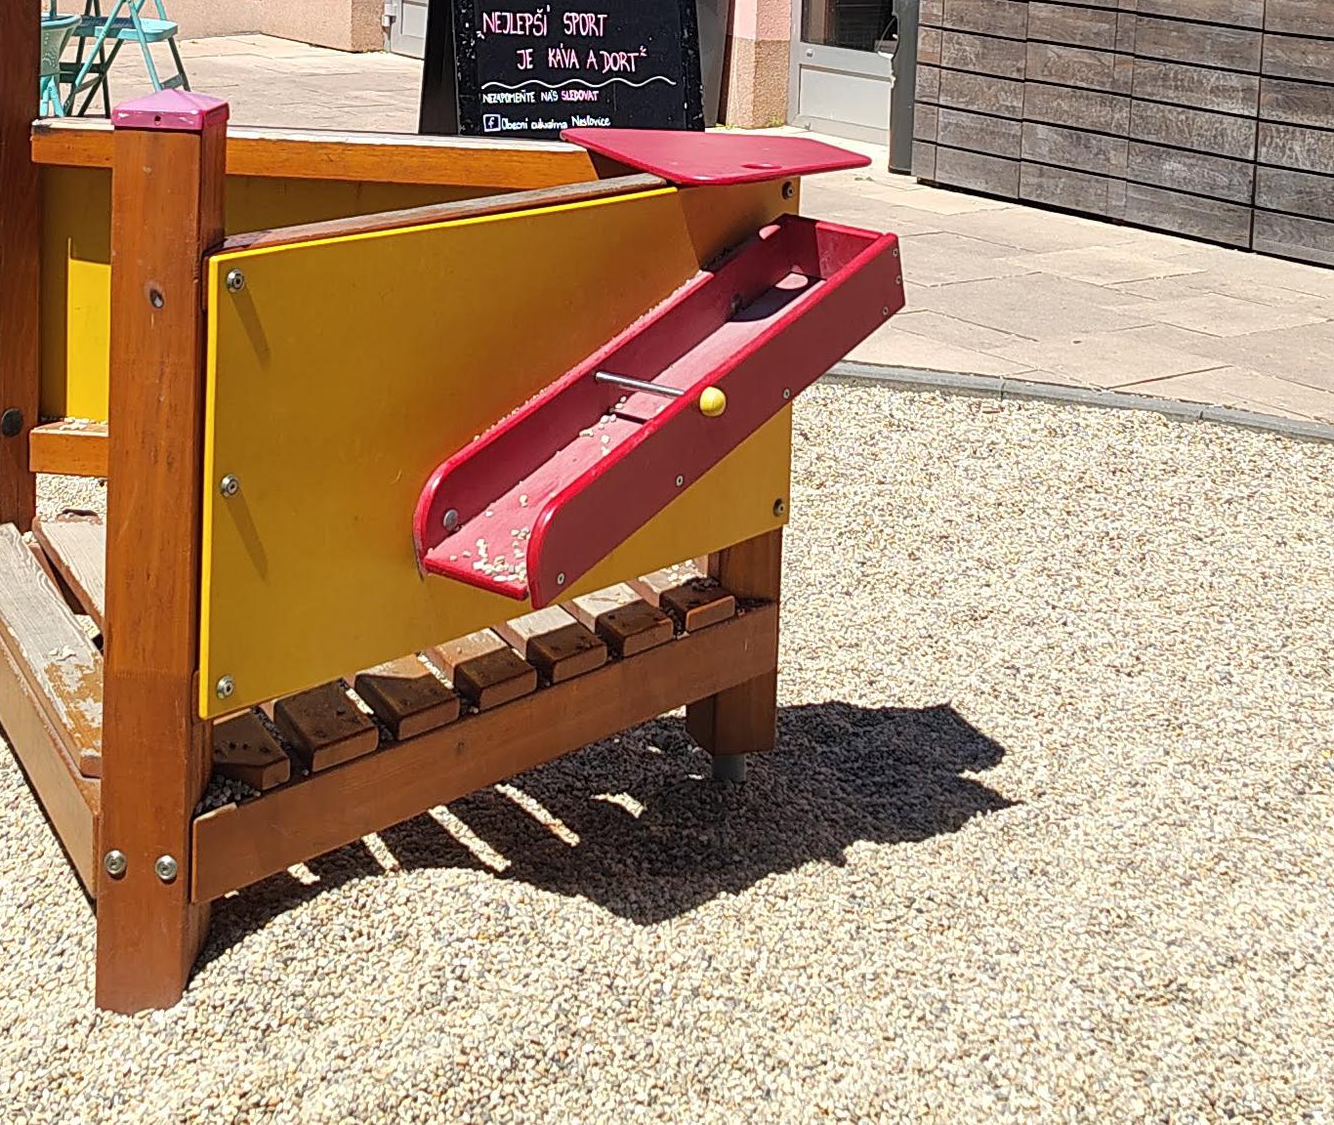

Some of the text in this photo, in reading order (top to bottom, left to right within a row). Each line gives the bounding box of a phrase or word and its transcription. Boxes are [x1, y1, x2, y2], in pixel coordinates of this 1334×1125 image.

[483, 5, 607, 37] NEJLEPŠÍ SPORT
[517, 43, 639, 74] JE KÁVA A DORT
[541, 90, 558, 101] NÁS
[561, 89, 599, 101] SLEDOVAT
